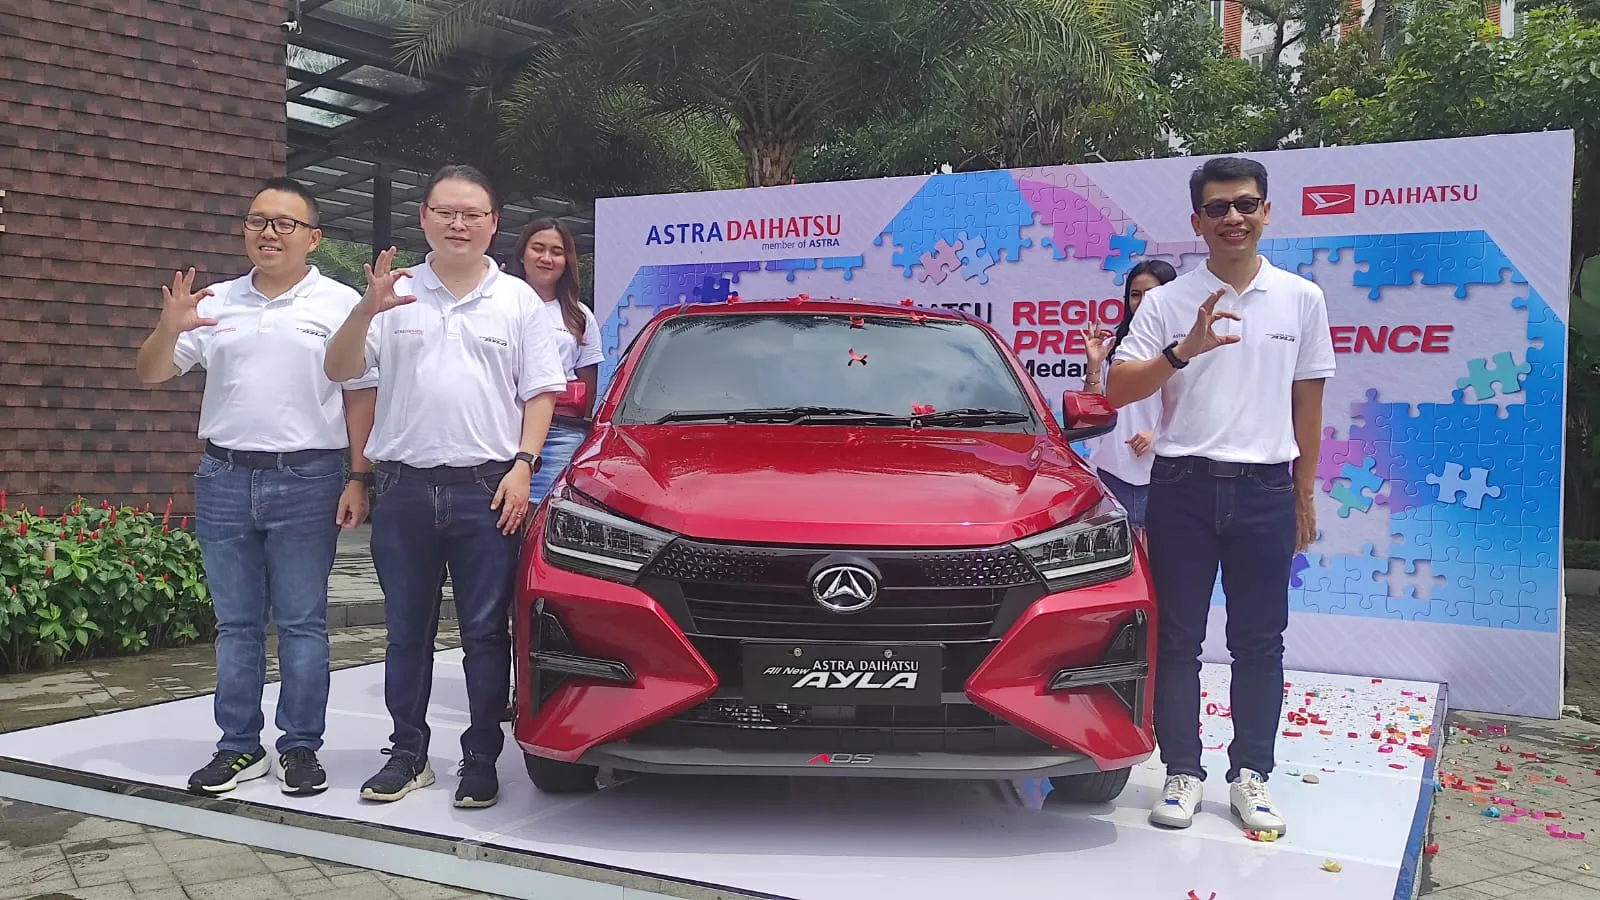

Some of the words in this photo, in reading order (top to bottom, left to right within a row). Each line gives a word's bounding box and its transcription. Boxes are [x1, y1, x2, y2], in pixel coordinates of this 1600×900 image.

[1364, 184, 1478, 206] DAIHATSU
[645, 222, 723, 246] ASTRA
[726, 214, 841, 241] DAIHATSU
[761, 240, 795, 251] member
[798, 239, 807, 249] of
[808, 238, 840, 249] ASTRA
[1012, 299, 1124, 327] REGIO
[1013, 329, 1117, 356] PRE
[1330, 325, 1453, 353] ENCE
[1024, 359, 1088, 378] Meda
[763, 667, 780, 675] All
[782, 667, 810, 675] New
[812, 660, 855, 671] ASTRA
[859, 660, 919, 671] DAIHATSU
[791, 671, 918, 689] AYLA
